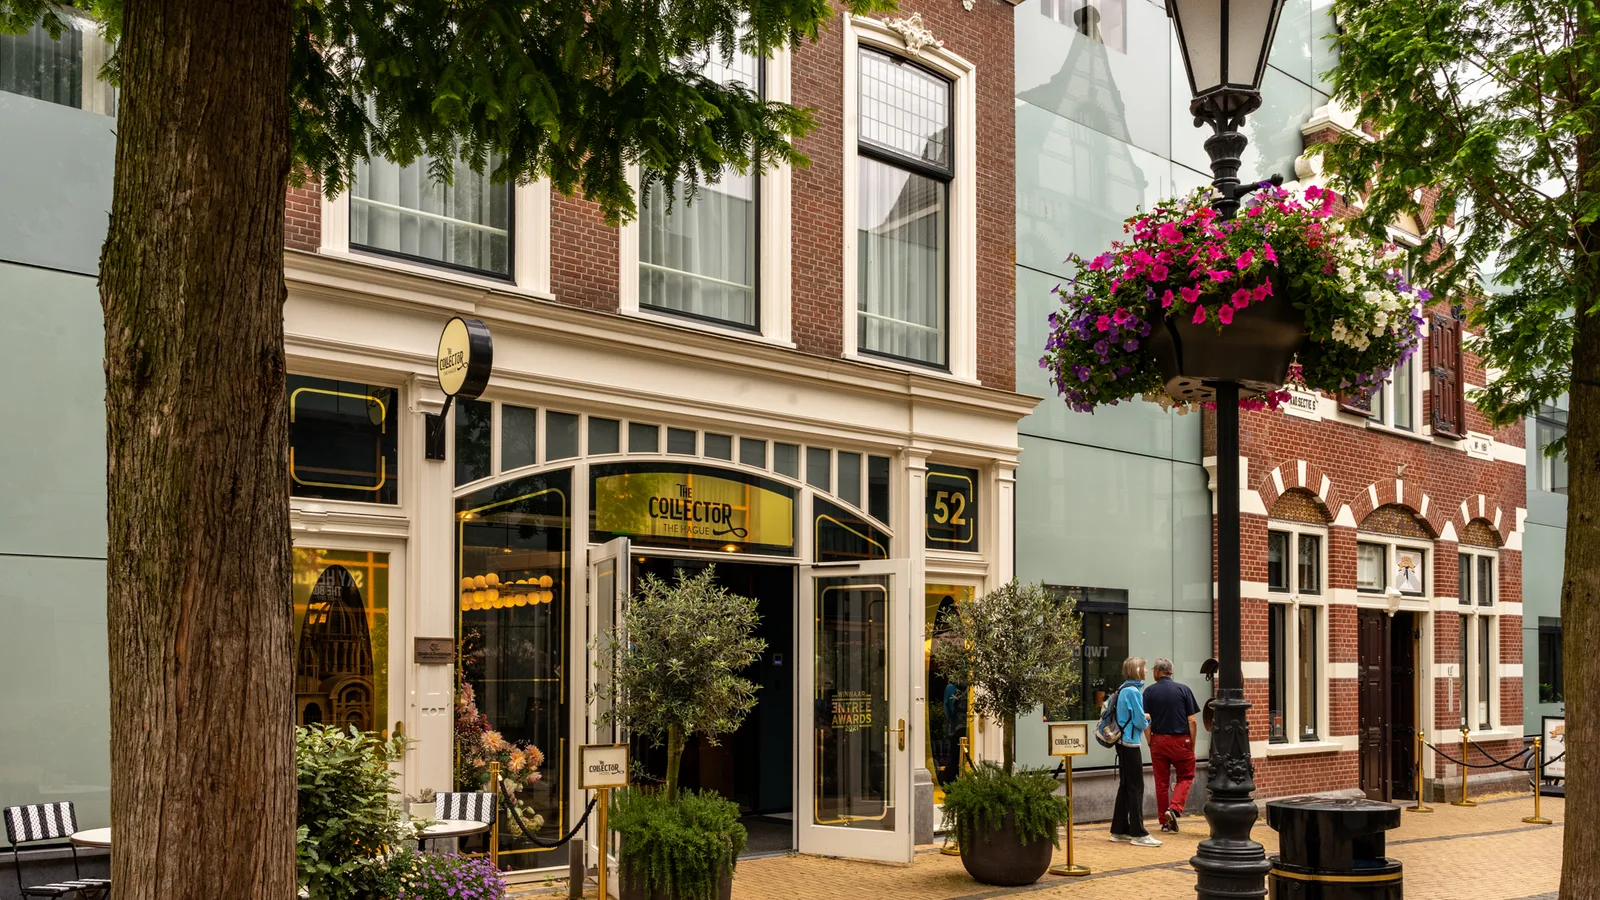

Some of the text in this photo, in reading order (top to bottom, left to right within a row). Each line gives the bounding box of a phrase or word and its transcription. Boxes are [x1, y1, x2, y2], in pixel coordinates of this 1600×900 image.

[440, 351, 469, 371] COLLECTOR
[676, 483, 692, 498] THE
[933, 491, 966, 526] 52
[649, 496, 748, 538] COLLECTOR
[663, 523, 710, 535] THE HAGUE
[831, 701, 872, 713] ENTREE
[831, 713, 872, 725] AWARDS
[1055, 738, 1084, 748] COLLECTOR
[589, 764, 624, 775] COLLECTOR
